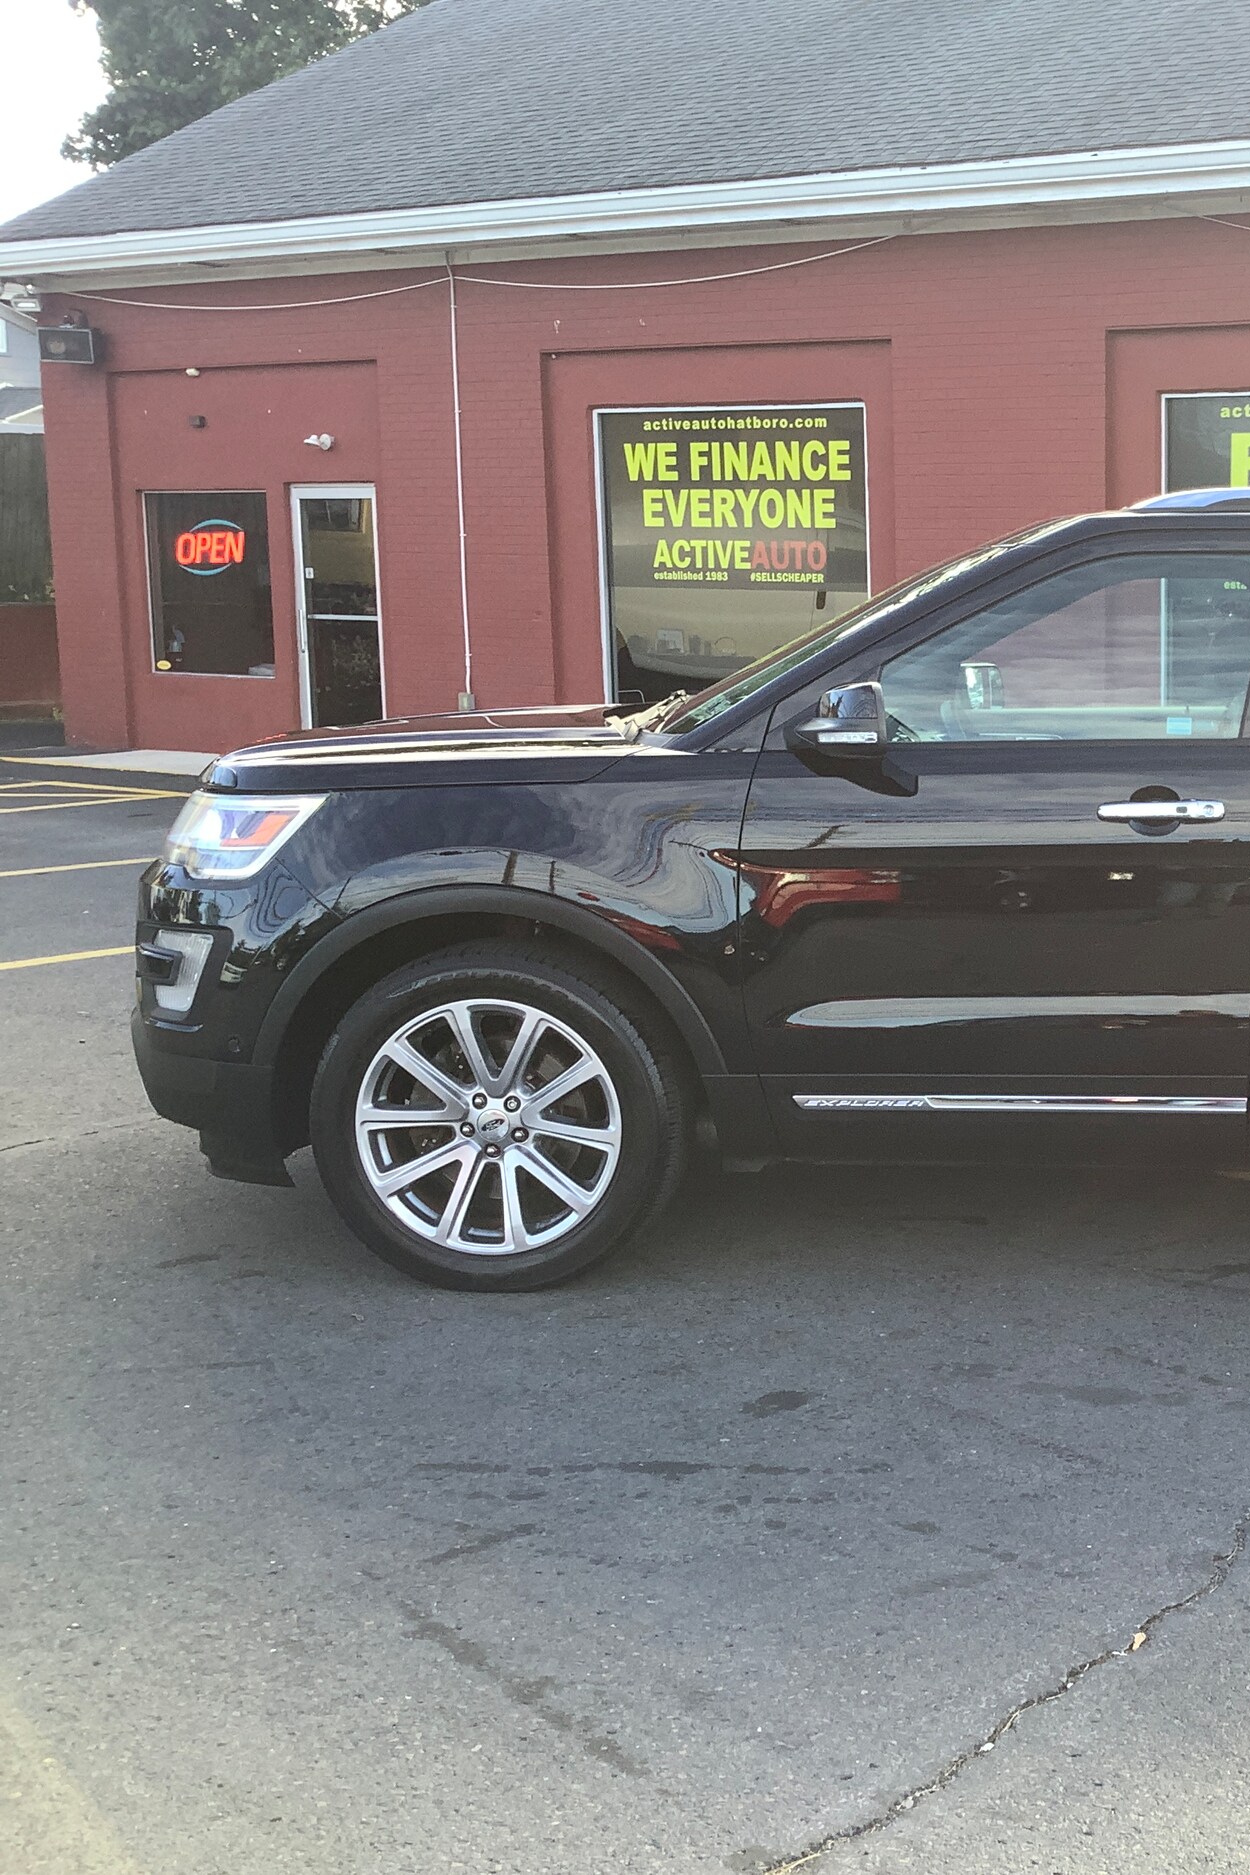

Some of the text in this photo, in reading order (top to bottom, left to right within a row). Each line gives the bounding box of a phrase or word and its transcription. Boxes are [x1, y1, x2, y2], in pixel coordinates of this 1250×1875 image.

[643, 416, 827, 431] activeautohatboro.com
[623, 440, 852, 482] WE FINANCE
[642, 488, 837, 529] EVERYONE
[175, 531, 244, 565] OPEN
[653, 571, 729, 581] established 1983
[750, 572, 825, 583] #SELLSCHEAPER
[804, 1099, 925, 1108] EXPLORER
